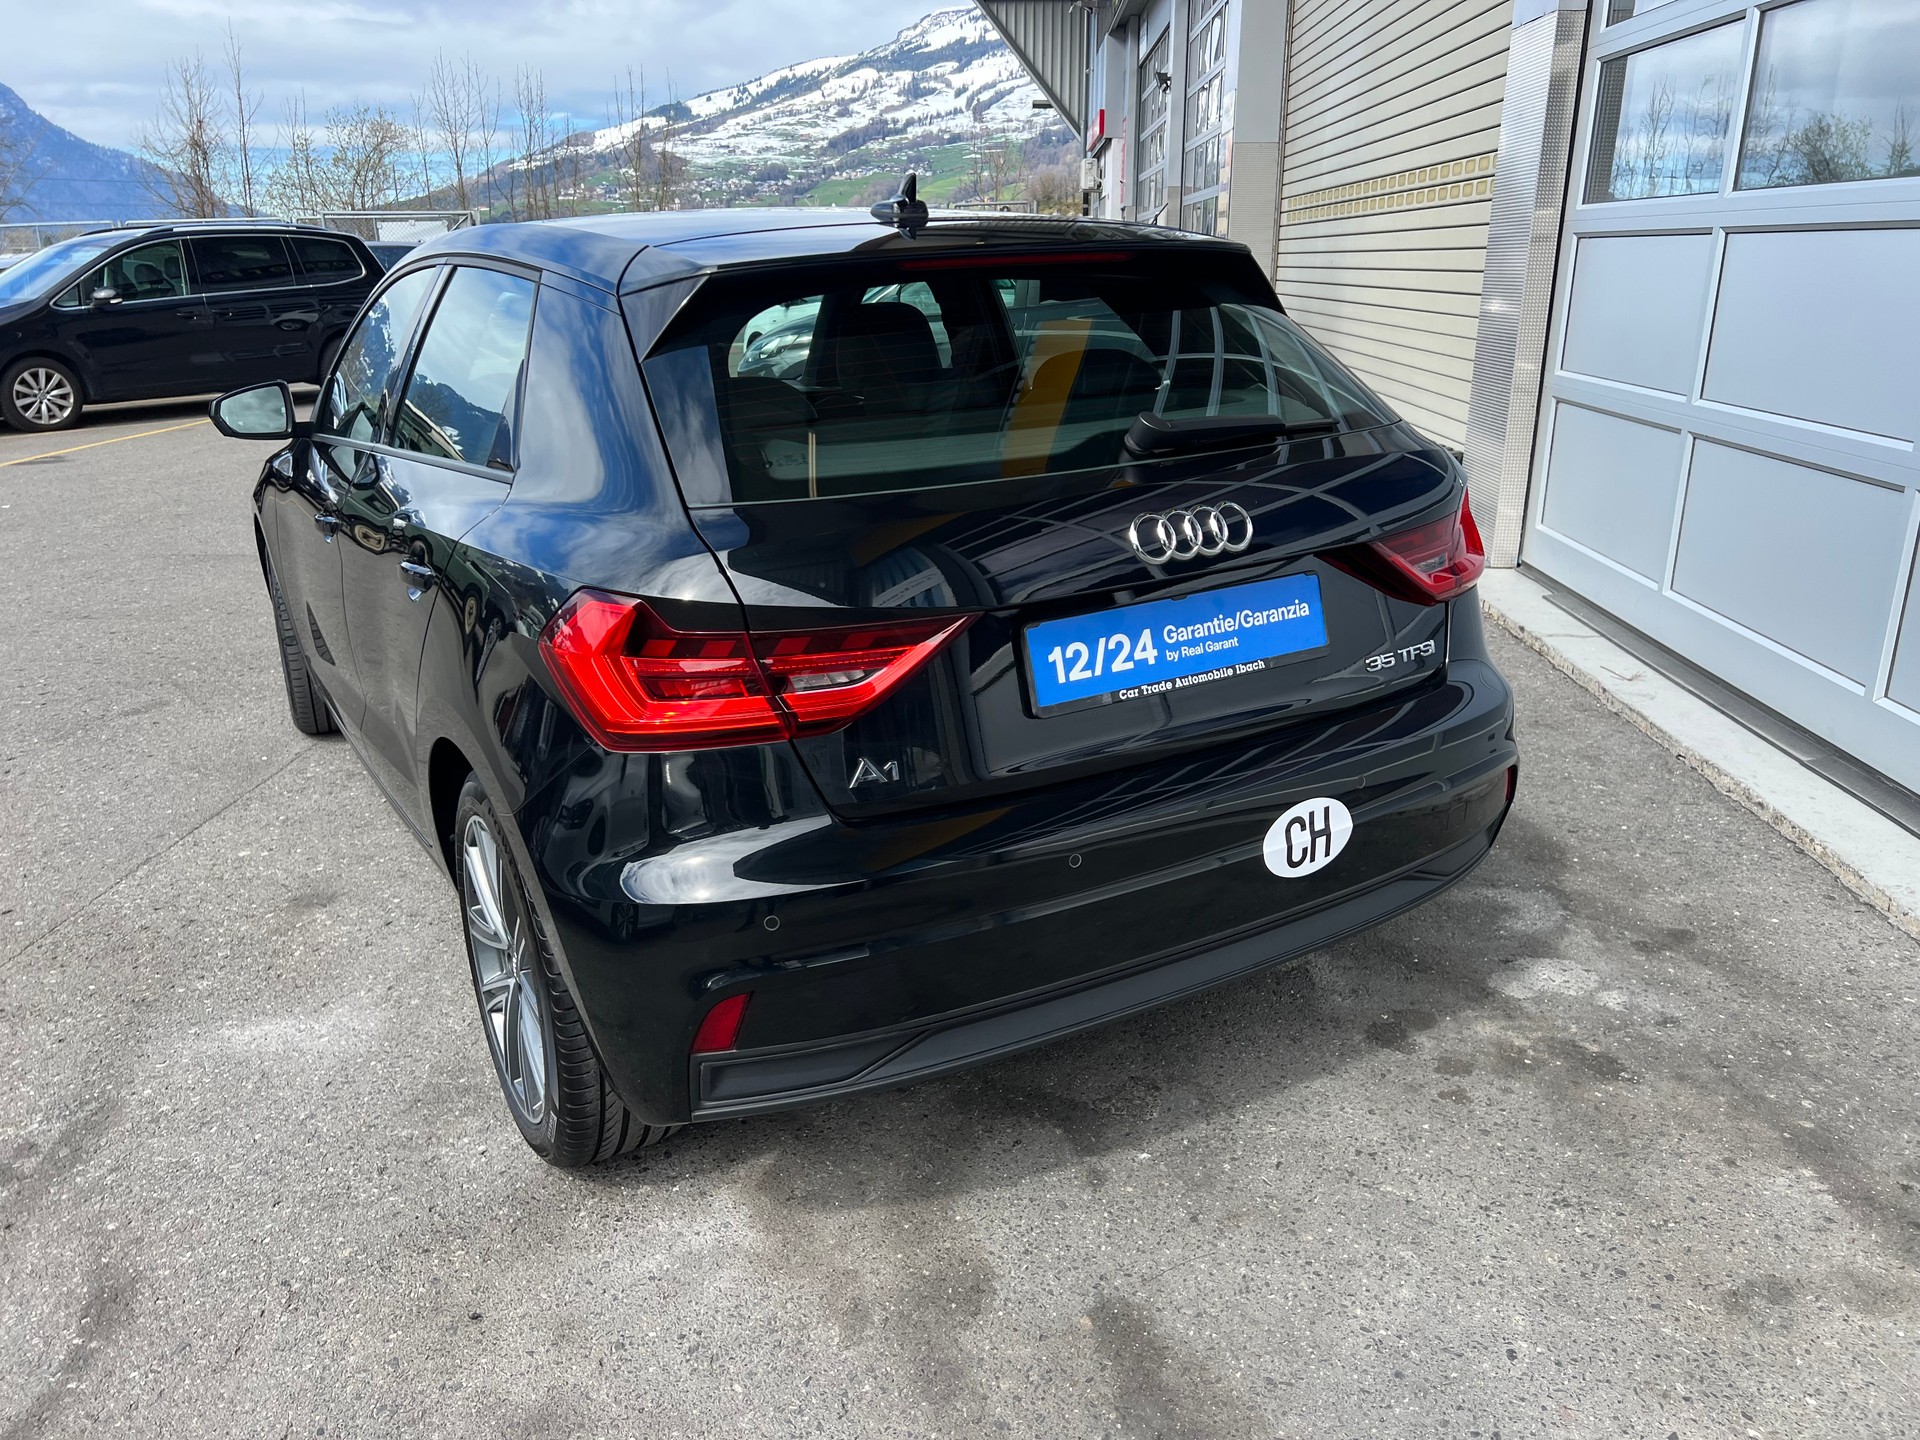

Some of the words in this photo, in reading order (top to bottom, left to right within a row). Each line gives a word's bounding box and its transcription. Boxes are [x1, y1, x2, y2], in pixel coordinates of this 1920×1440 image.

[1163, 599, 1310, 644] Garantie/Garanzia
[1047, 628, 1158, 684] 12/24
[1166, 649, 1180, 662] by
[1181, 643, 1204, 658] Real
[1205, 636, 1239, 652] Garant
[1365, 652, 1396, 672] 35
[1397, 639, 1436, 663] TFSI
[1118, 688, 1139, 700] Car
[1141, 680, 1173, 695] Trade
[1175, 665, 1234, 688] Automobile
[1236, 660, 1266, 674] Ibach
[849, 757, 900, 789] A1
[1284, 805, 1332, 869] CH
